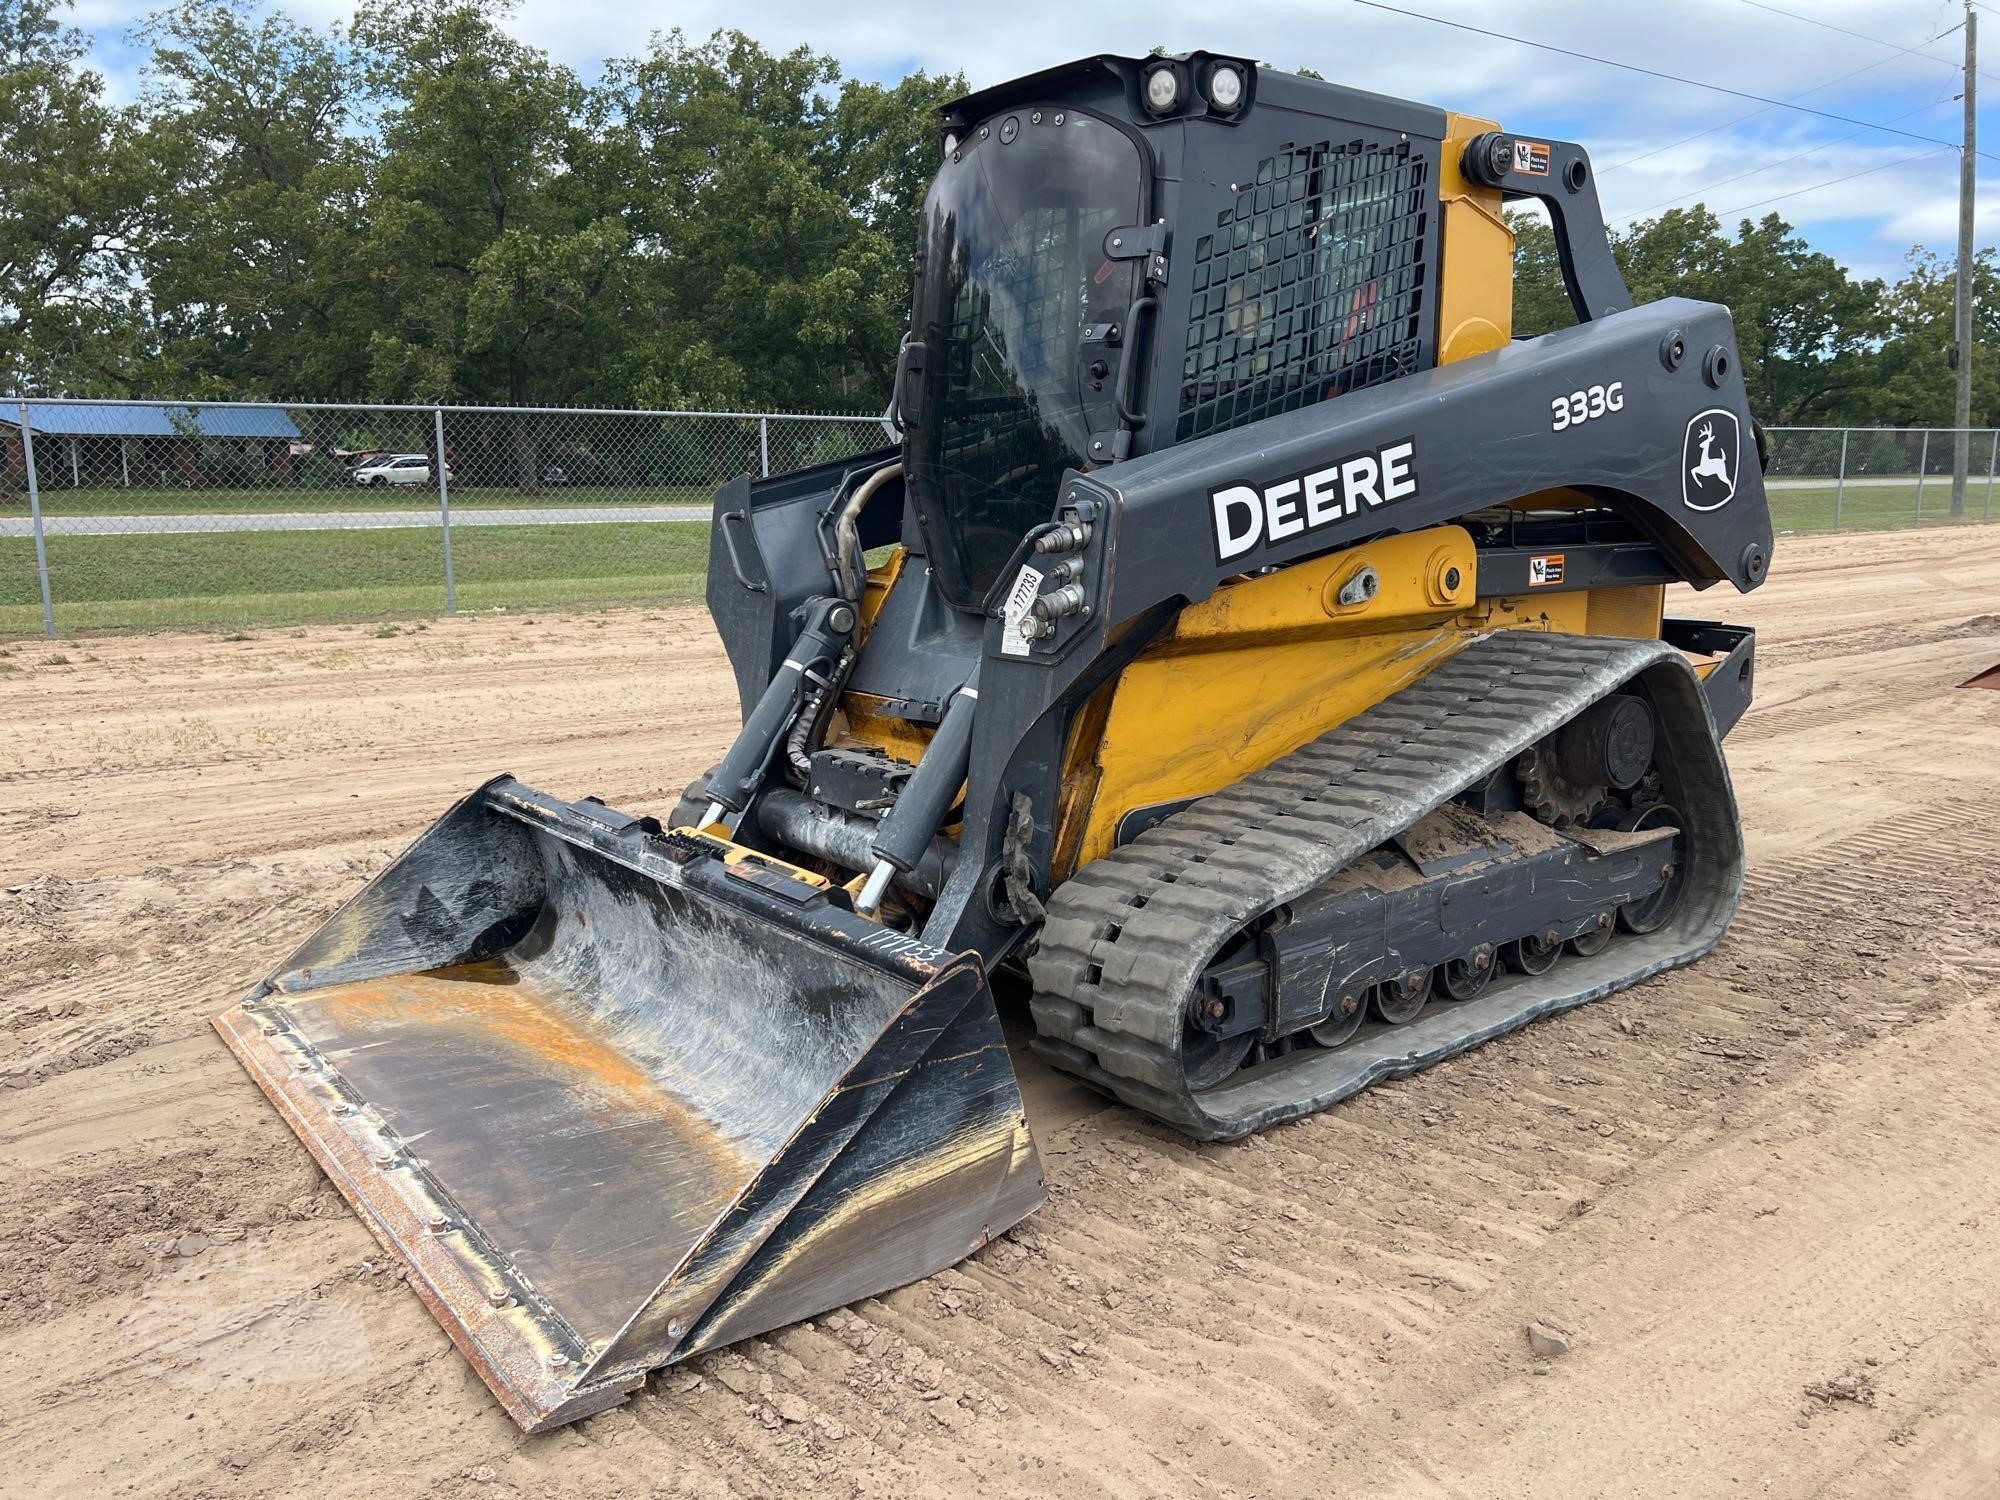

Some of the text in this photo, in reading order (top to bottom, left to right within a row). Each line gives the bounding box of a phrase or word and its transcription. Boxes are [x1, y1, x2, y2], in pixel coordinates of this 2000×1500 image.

[1551, 381, 1624, 431] 333G
[1212, 442, 1416, 560] DEERE
[1013, 572, 1038, 609] 177733
[858, 928, 945, 961] 177733
